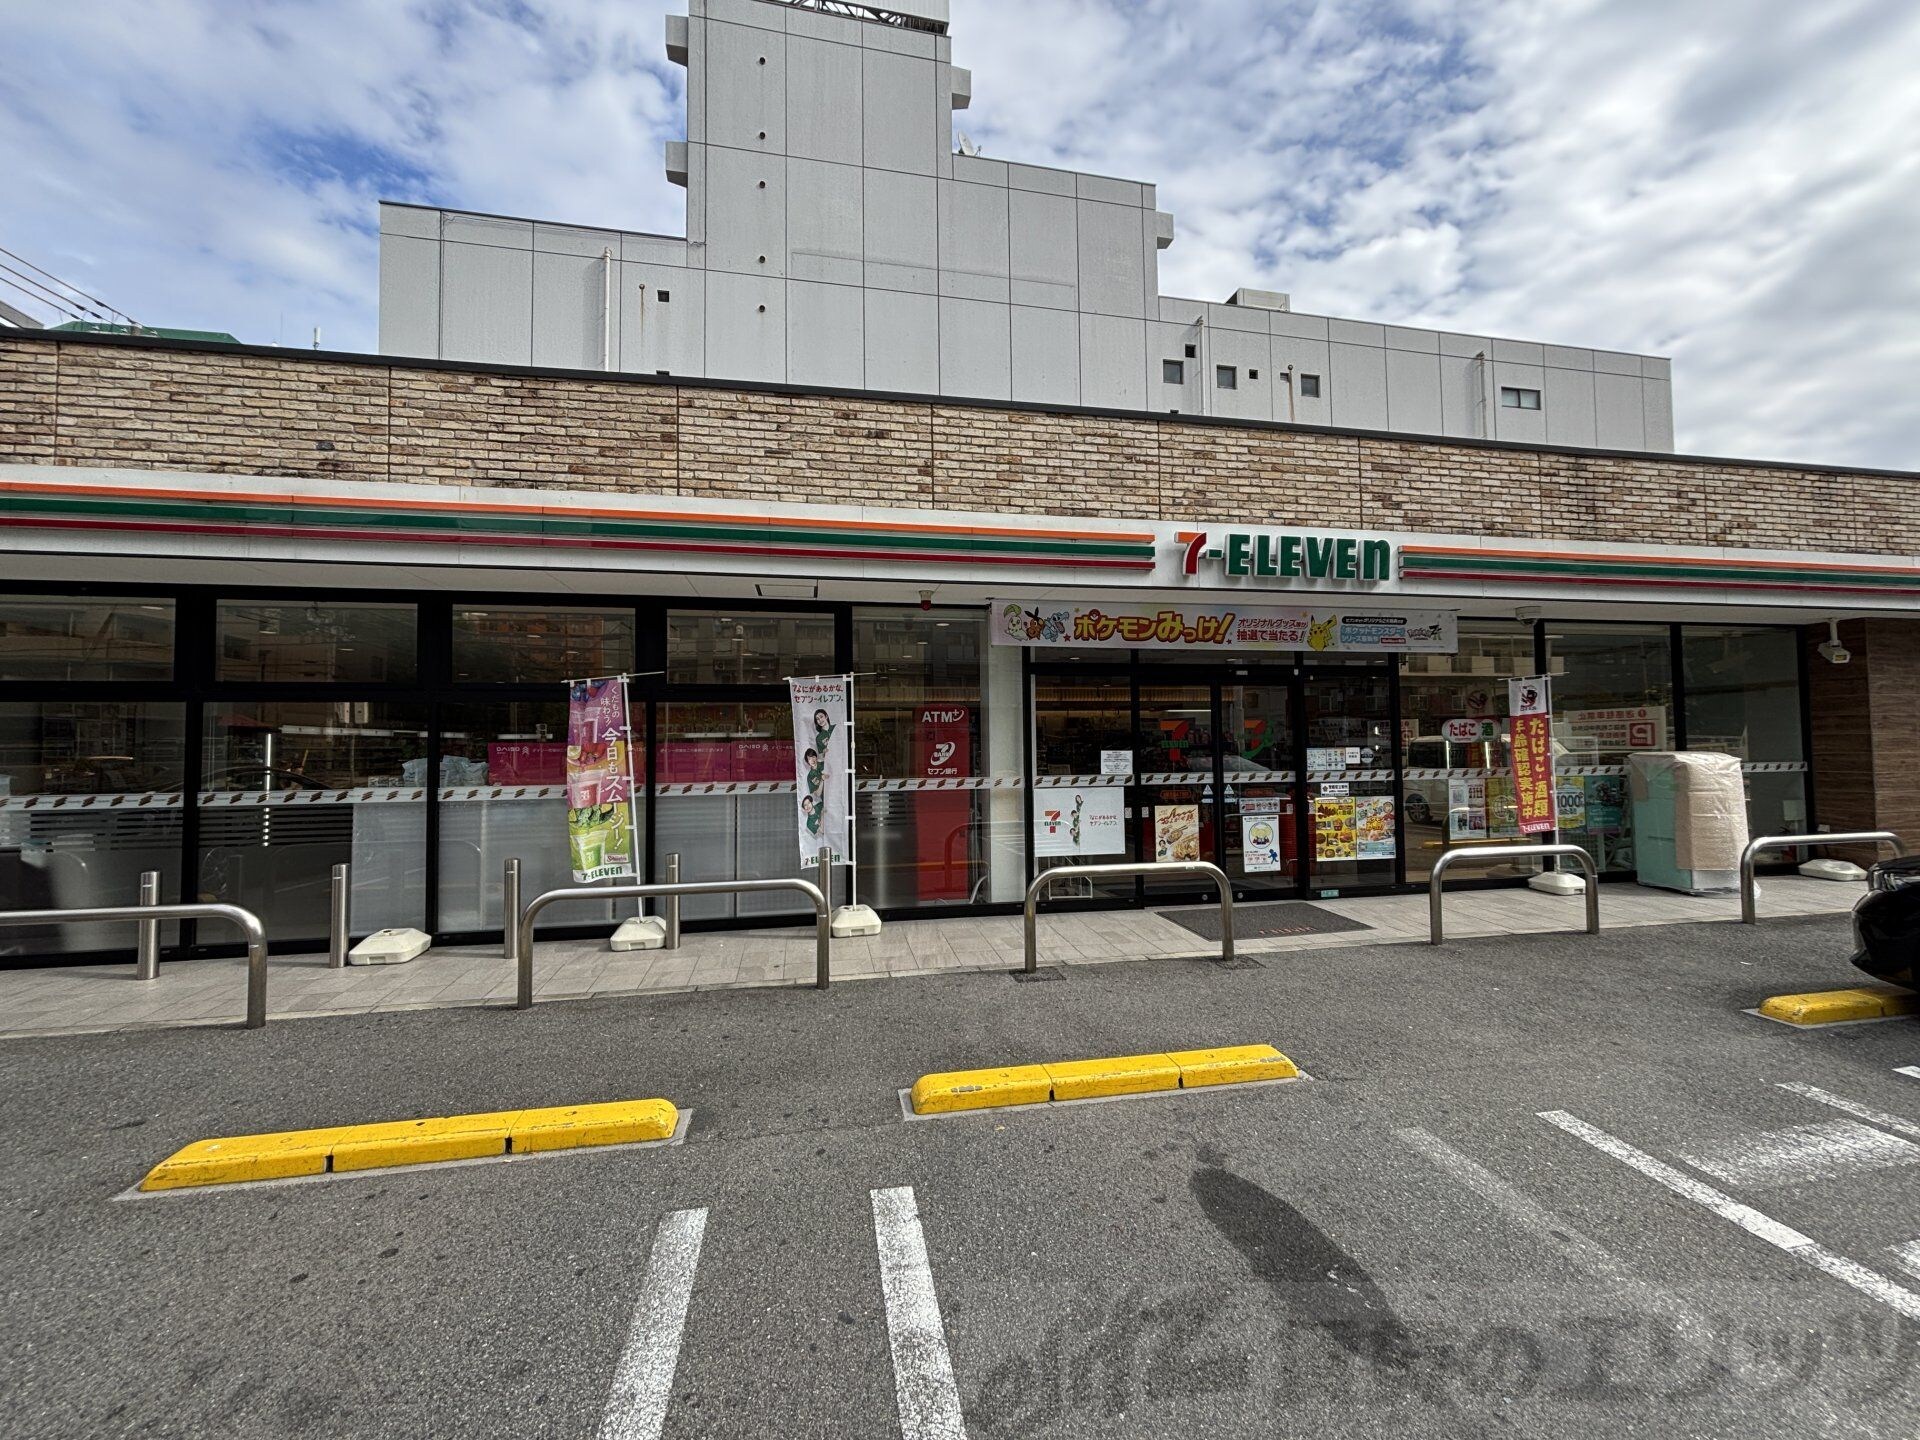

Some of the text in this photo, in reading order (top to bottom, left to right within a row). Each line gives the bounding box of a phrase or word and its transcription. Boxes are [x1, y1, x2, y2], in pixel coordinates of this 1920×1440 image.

[611, 686, 620, 718] くだもの
[1449, 722, 1494, 737] たばこ 酒
[927, 767, 958, 775] セブン銀行
[1514, 719, 1533, 819] 年齢確認実施中
[602, 727, 623, 850] 今日もスムージー!
